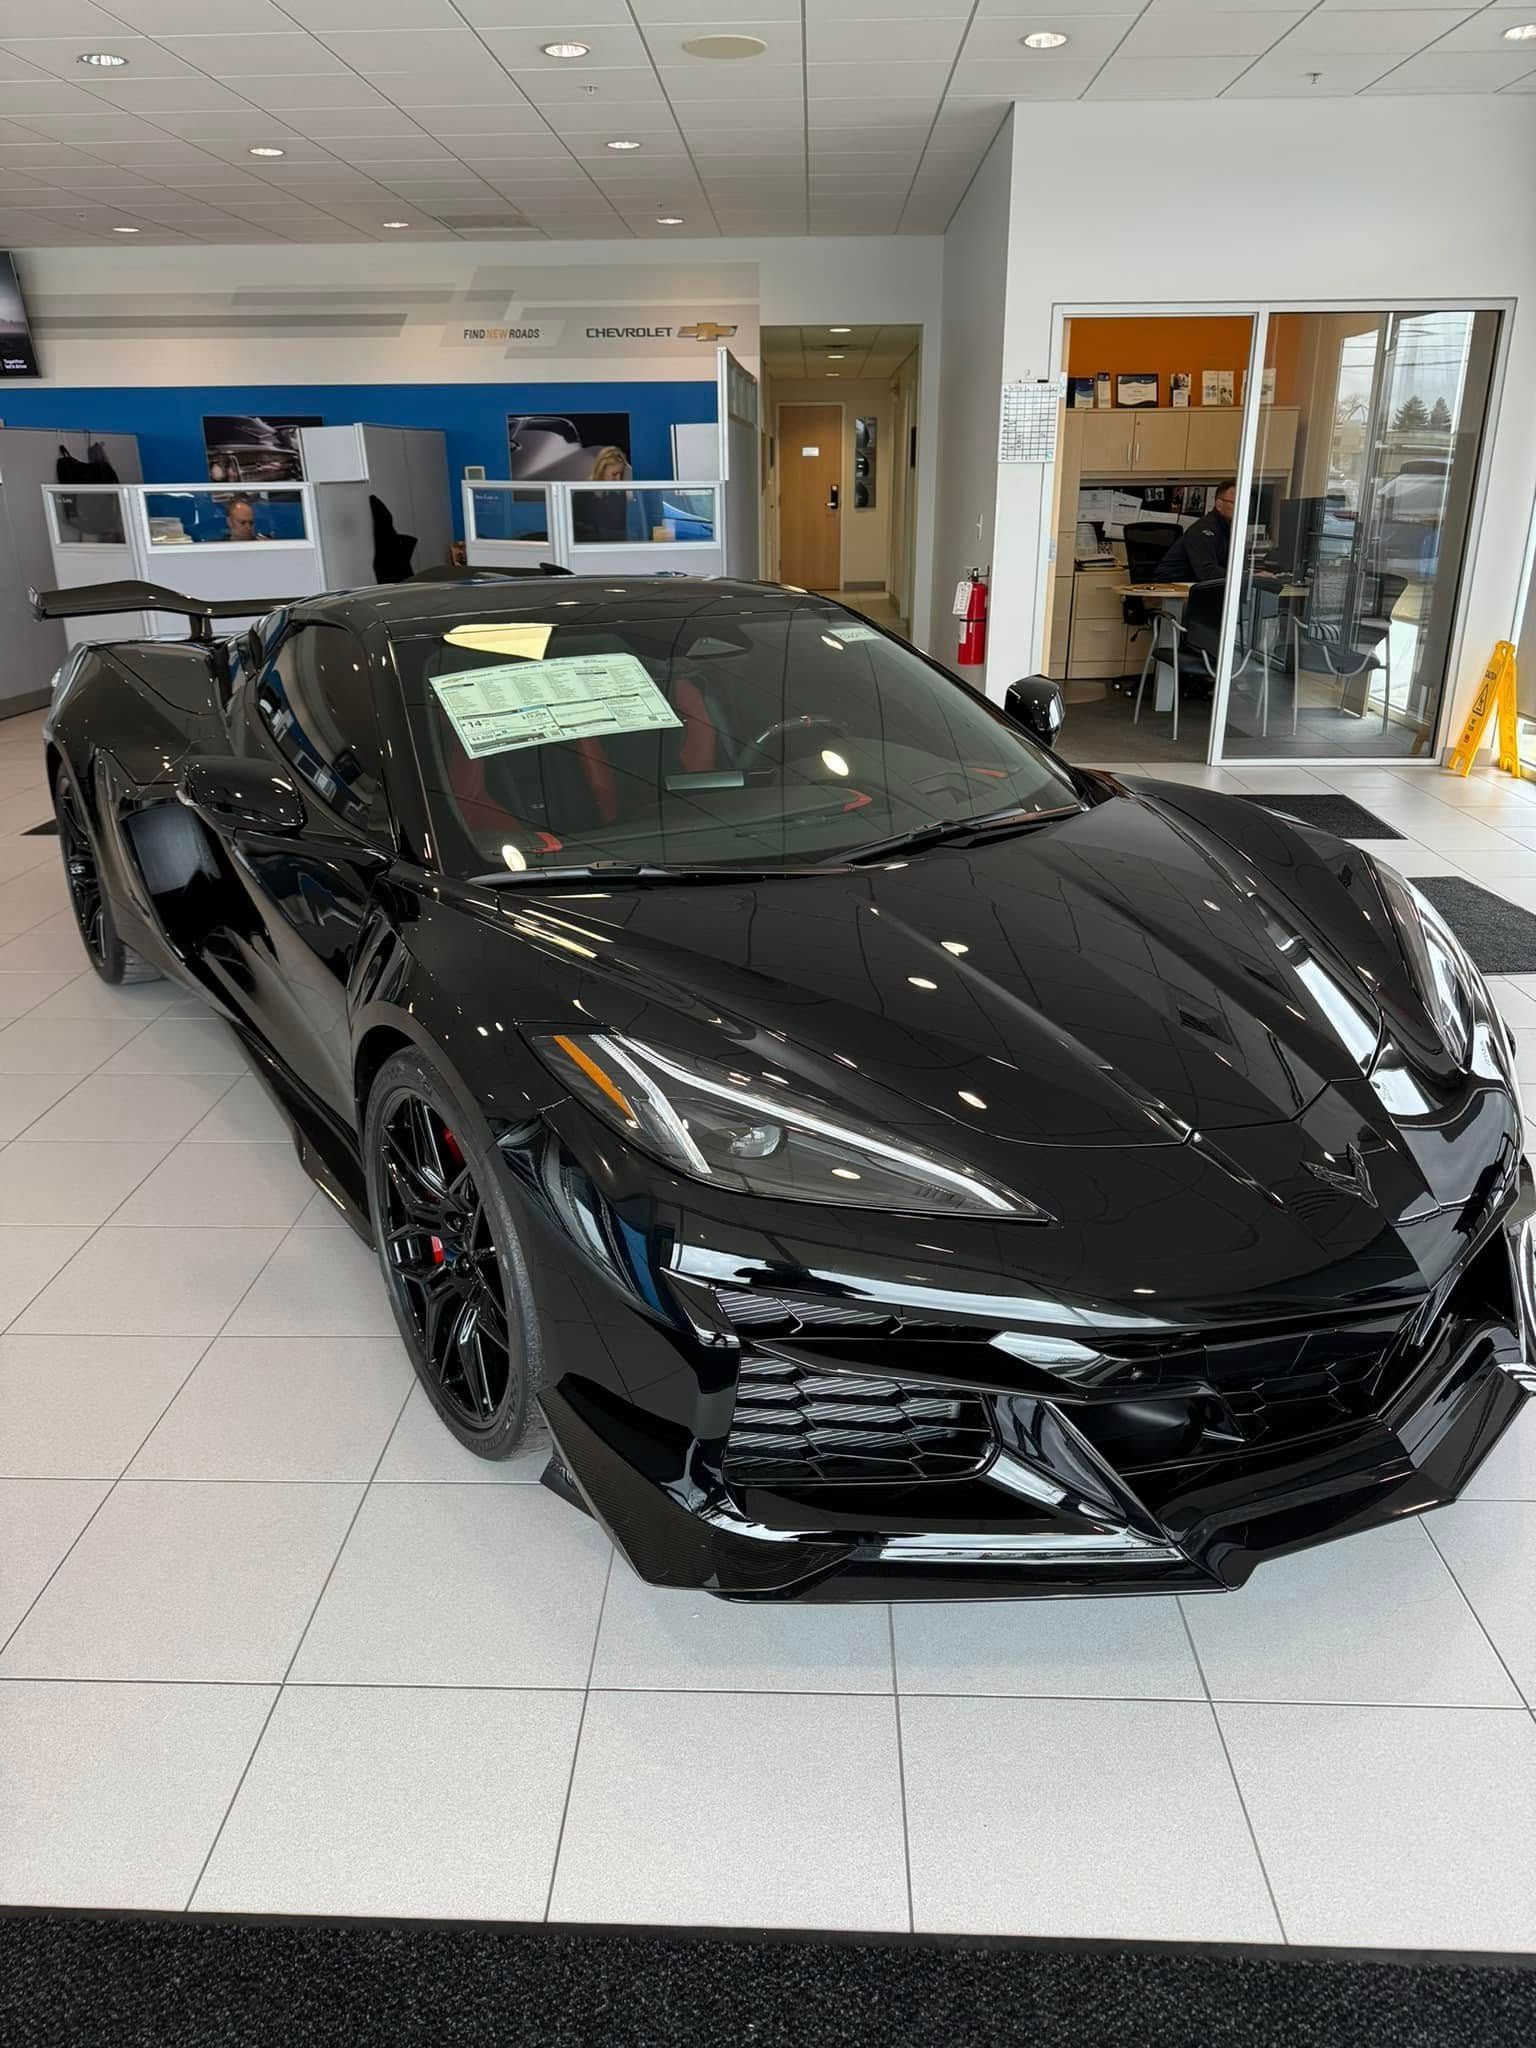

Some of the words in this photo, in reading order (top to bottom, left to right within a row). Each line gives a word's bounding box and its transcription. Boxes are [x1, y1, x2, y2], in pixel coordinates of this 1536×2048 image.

[463, 328, 486, 339] FIND
[486, 328, 508, 339] NEW
[508, 328, 540, 338] ROADS
[586, 327, 673, 338] CHEVROLET
